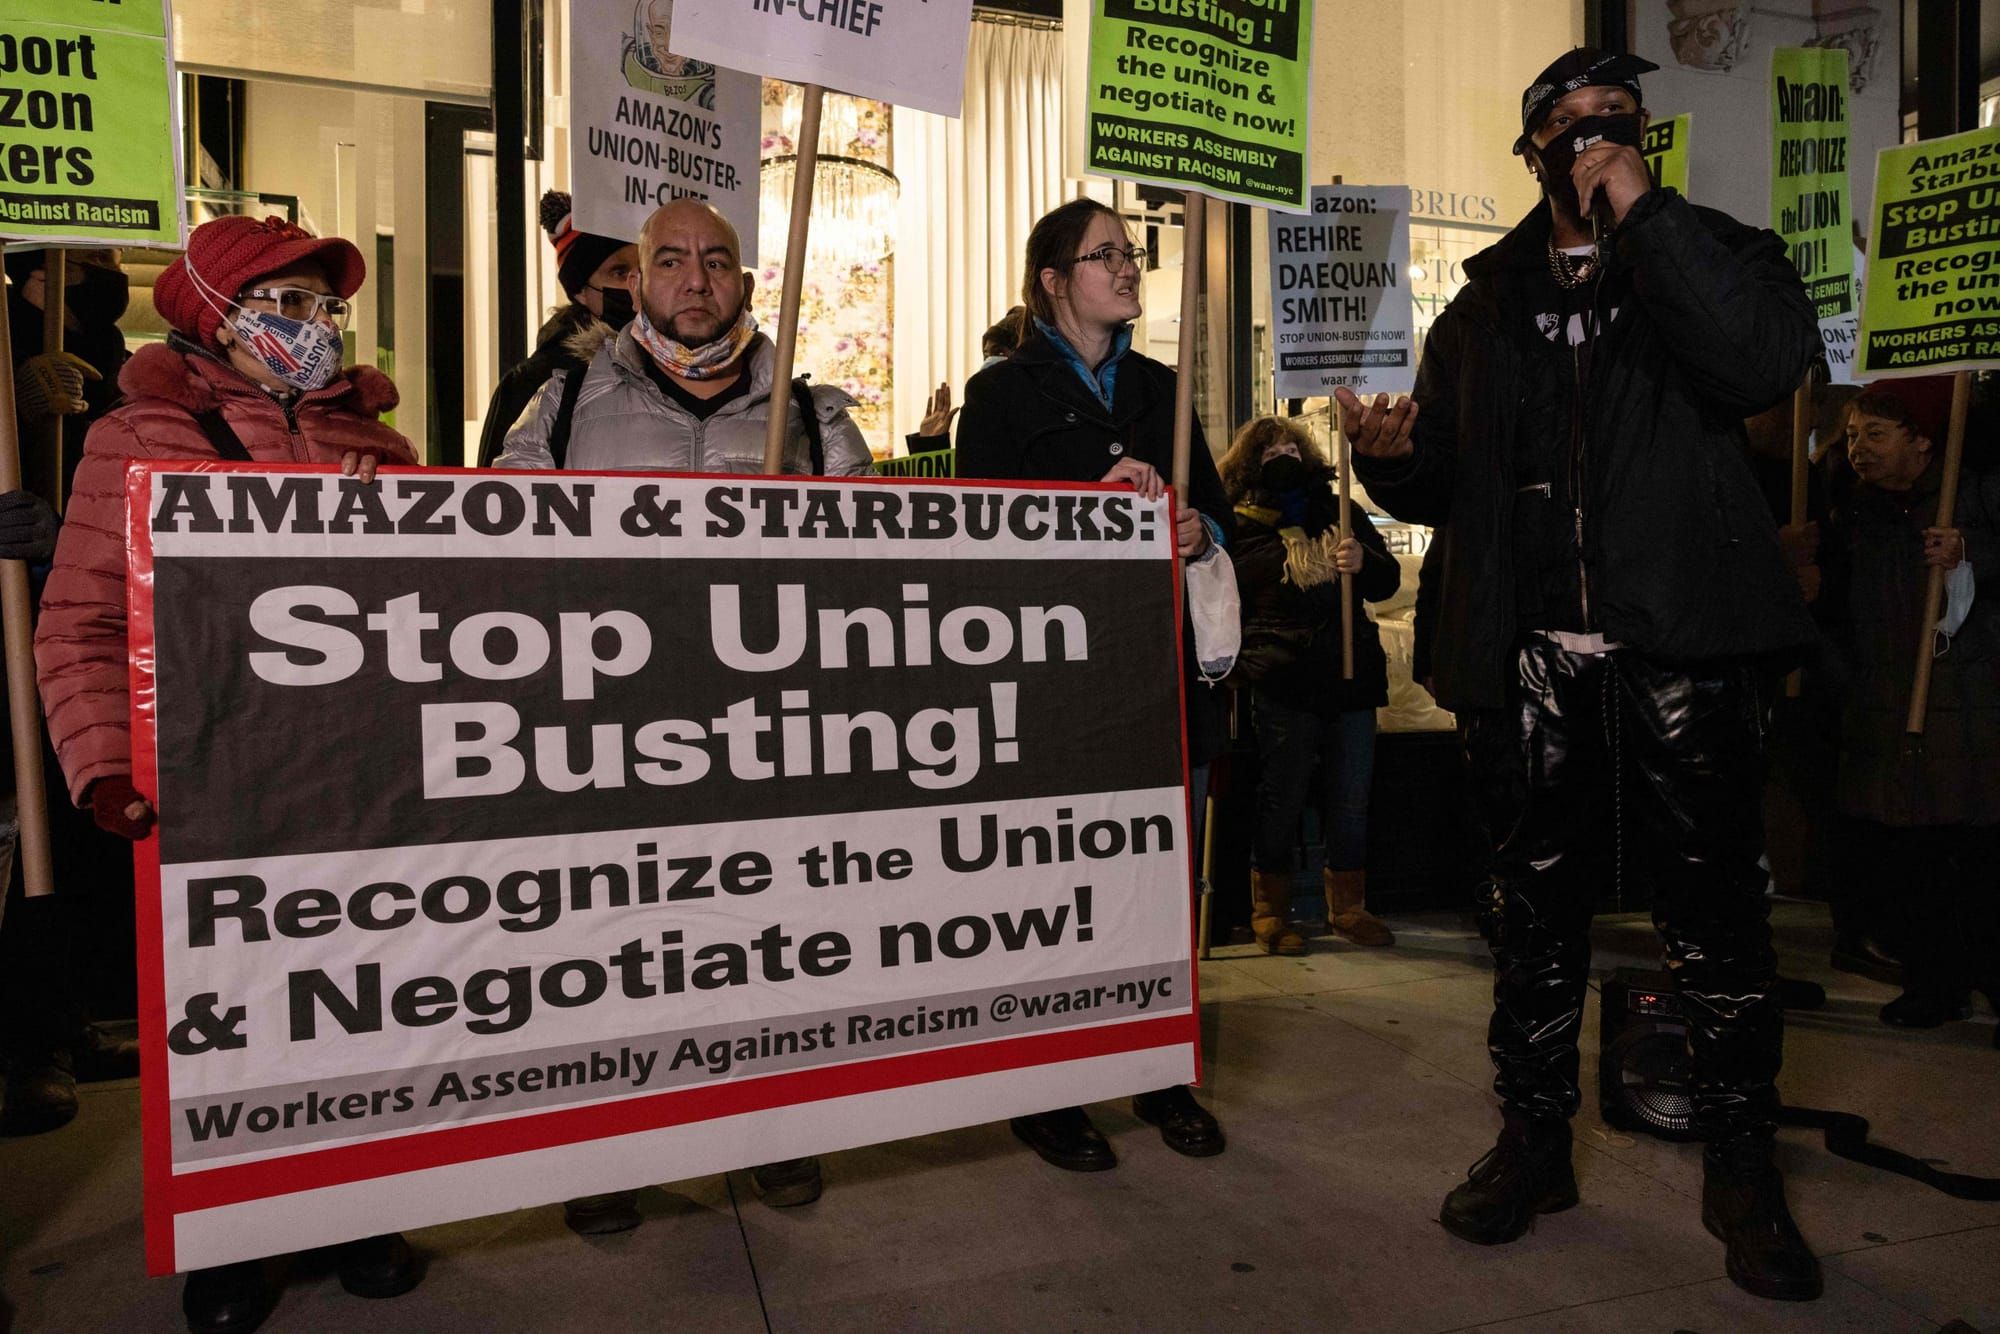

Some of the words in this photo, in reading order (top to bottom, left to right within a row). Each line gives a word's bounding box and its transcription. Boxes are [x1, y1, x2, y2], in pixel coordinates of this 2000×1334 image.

[1126, 26, 1270, 77] Recognize
[1117, 54, 1166, 79] the
[1174, 65, 1249, 100] union
[1257, 84, 1276, 106] &
[615, 96, 722, 150] AMAZON'S
[1100, 83, 1227, 122] negotiate
[1233, 110, 1295, 137] now!
[589, 126, 742, 191] UNION-BUSTER-
[1097, 121, 1189, 149] WORKERS
[1193, 137, 1278, 169] ASSEMBLY
[0, 143, 94, 186] ers
[1095, 145, 1174, 170] AGAINST
[1178, 157, 1241, 185] RACISM
[1245, 178, 1294, 195] @waar-nyc
[625, 176, 708, 207] IN-CH
[1311, 196, 1376, 214] azon:
[0, 198, 70, 220] Against
[76, 203, 149, 224] Racism
[1797, 190, 1841, 233] UION
[1887, 200, 1959, 227] Stop
[1277, 226, 1363, 253] REHIRE
[1279, 262, 1396, 291] DAEQUAN
[1897, 280, 1948, 301] the
[1957, 273, 2000, 291] un
[1282, 296, 1367, 324] SMITH!
[1817, 301, 1841, 318] CISM
[1280, 333, 1305, 344] STOP
[1307, 331, 1380, 343] UNION-BUSTING
[1381, 330, 1406, 340] NOW!
[1872, 325, 1966, 348] WORKERS
[1971, 323, 2000, 336] AS
[1889, 342, 1971, 364] AGAINST
[1285, 355, 1320, 366] WORKERS
[1320, 354, 1353, 364] ASSEMBLY
[1353, 353, 1378, 363] AGAINST
[1379, 353, 1402, 363] RACISM
[1828, 348, 1854, 364] IN-
[1321, 375, 1369, 388] waar_nyc
[152, 474, 596, 537] AMAZON
[620, 484, 682, 537] &
[705, 486, 1155, 542] STARBUCKS:
[249, 585, 652, 700] Stop
[710, 583, 1089, 673] Union
[421, 682, 1019, 799] Busting!
[186, 842, 773, 949] Recognize
[798, 840, 914, 888] the
[940, 808, 1174, 873] Union
[167, 992, 247, 1056] &
[288, 923, 851, 1042] Negotiate
[879, 885, 1093, 968] now!
[185, 1082, 414, 1143] Workers
[428, 1048, 659, 1107] Assembly
[668, 1022, 836, 1074] Against
[847, 1002, 979, 1046] Racism
[990, 975, 1172, 1023] @waar-nyc
